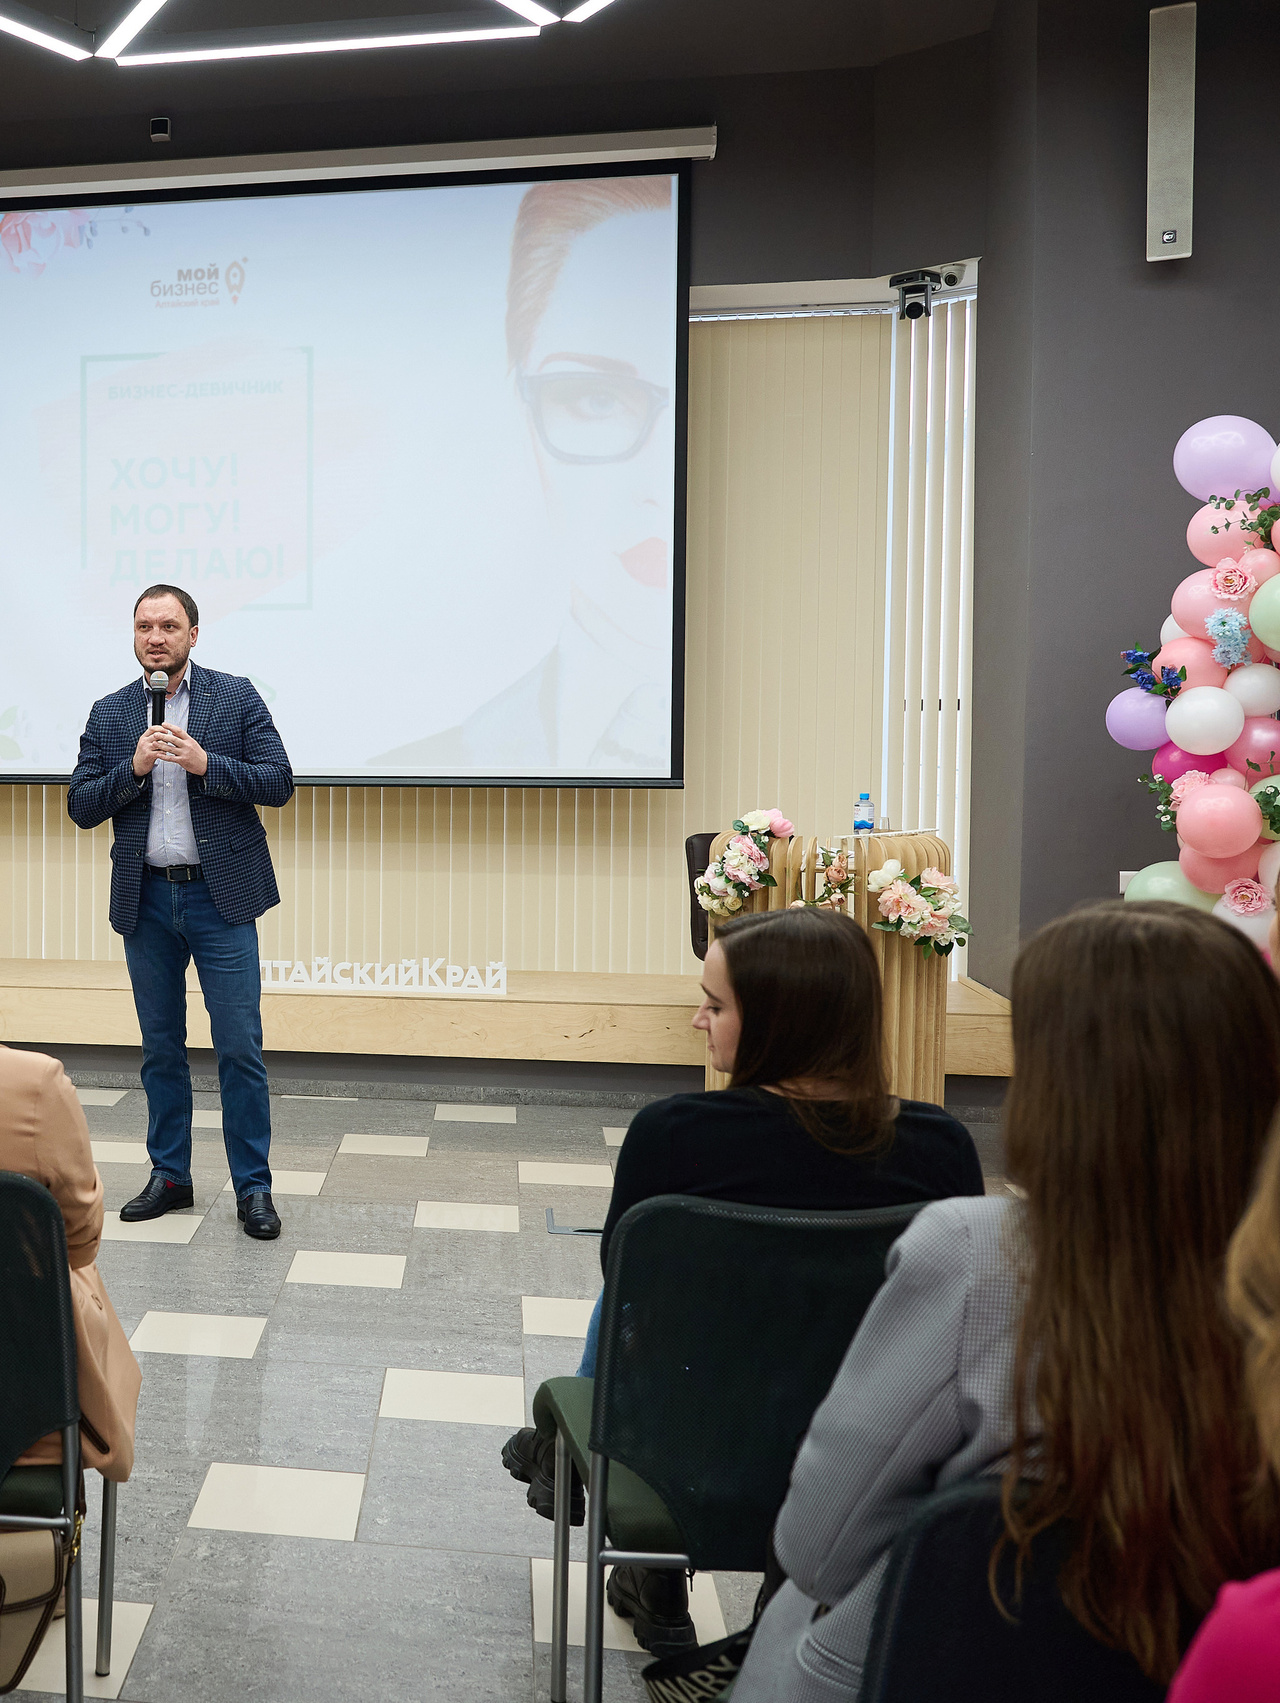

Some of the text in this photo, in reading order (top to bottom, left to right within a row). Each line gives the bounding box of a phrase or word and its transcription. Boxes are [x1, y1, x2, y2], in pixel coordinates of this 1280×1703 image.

[177, 263, 219, 281] мой
[150, 280, 219, 297] бизнес
[108, 380, 283, 401] БИЗНЕС-ДЕВИЧНИК
[109, 452, 238, 490] ХОЧУ!
[110, 499, 240, 536] МОГУ!
[109, 542, 284, 588] ДЕЛАЮ!
